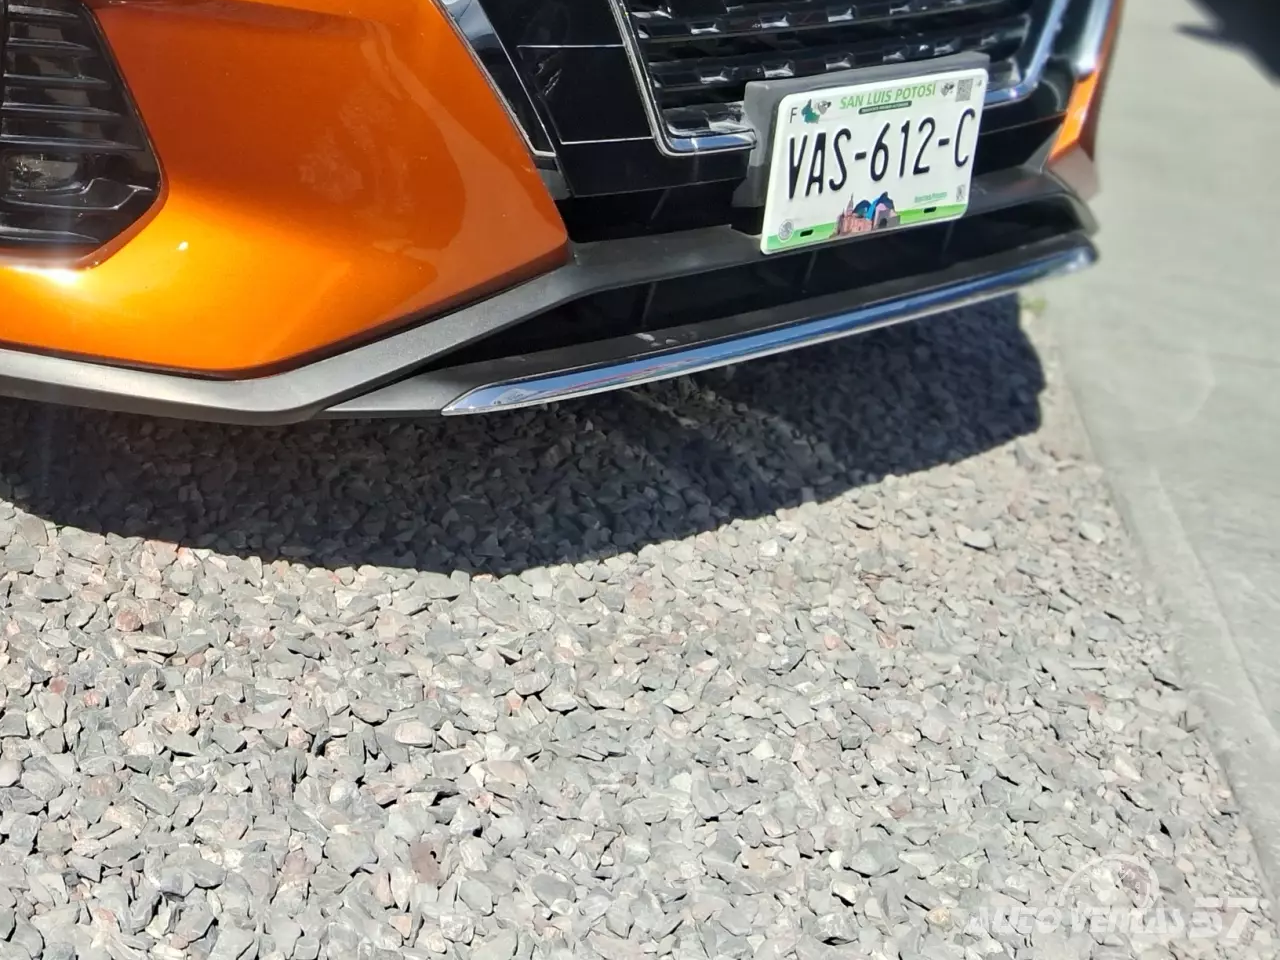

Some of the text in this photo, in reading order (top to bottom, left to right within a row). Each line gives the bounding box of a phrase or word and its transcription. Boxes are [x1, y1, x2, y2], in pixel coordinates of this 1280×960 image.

[839, 95, 864, 109] SAN
[867, 90, 892, 105] LUIS
[894, 83, 937, 101] POTOSI
[788, 107, 976, 200] VAS-612-C
